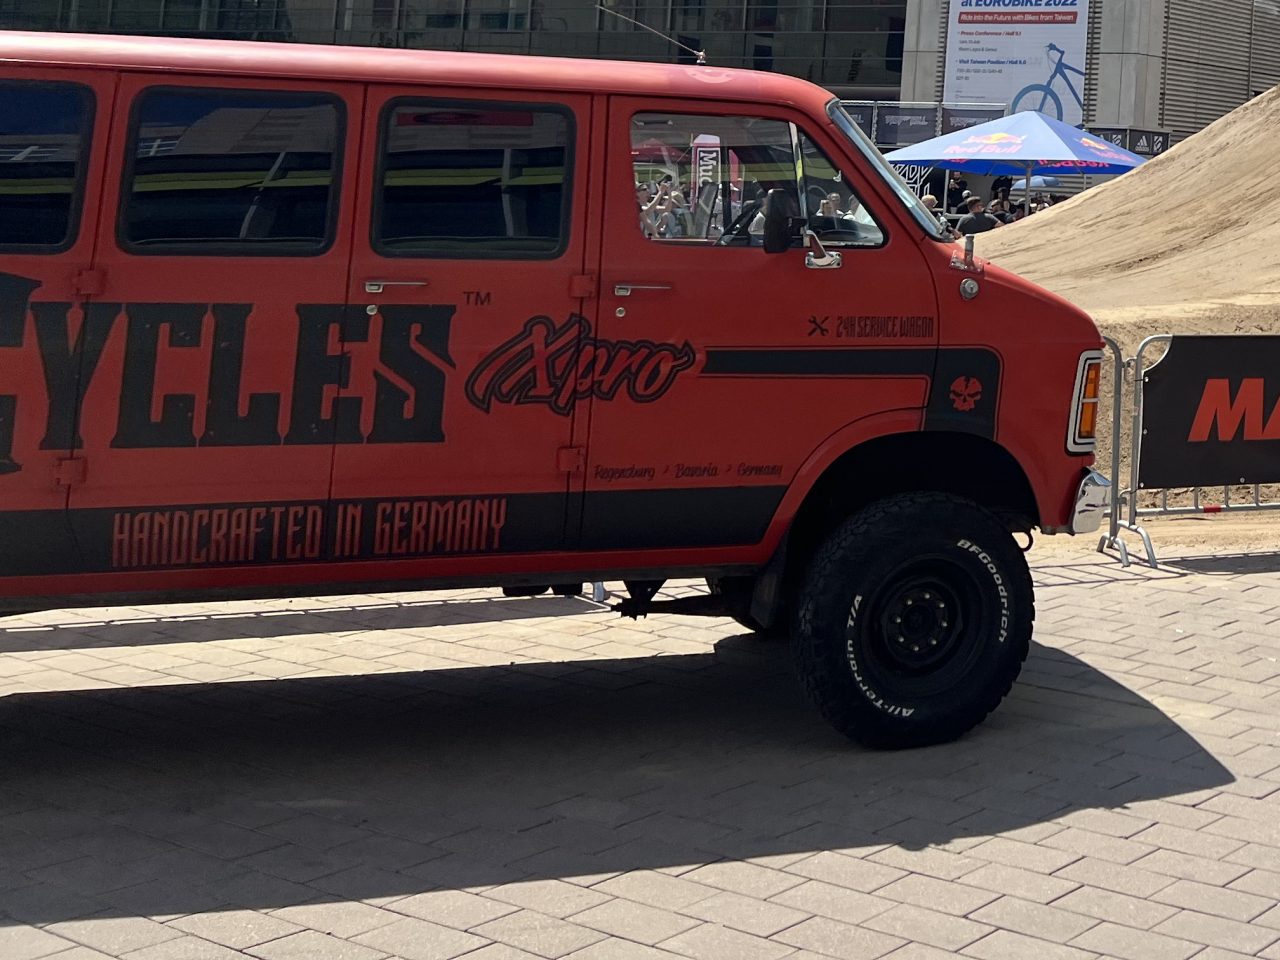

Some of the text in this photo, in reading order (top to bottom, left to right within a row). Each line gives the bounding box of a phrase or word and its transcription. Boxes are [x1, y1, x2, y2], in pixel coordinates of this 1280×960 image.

[856, 316, 897, 337] SERVICE
[899, 316, 934, 337] WAGON
[111, 497, 508, 573] HANDCRAFTED IN GERMANY
